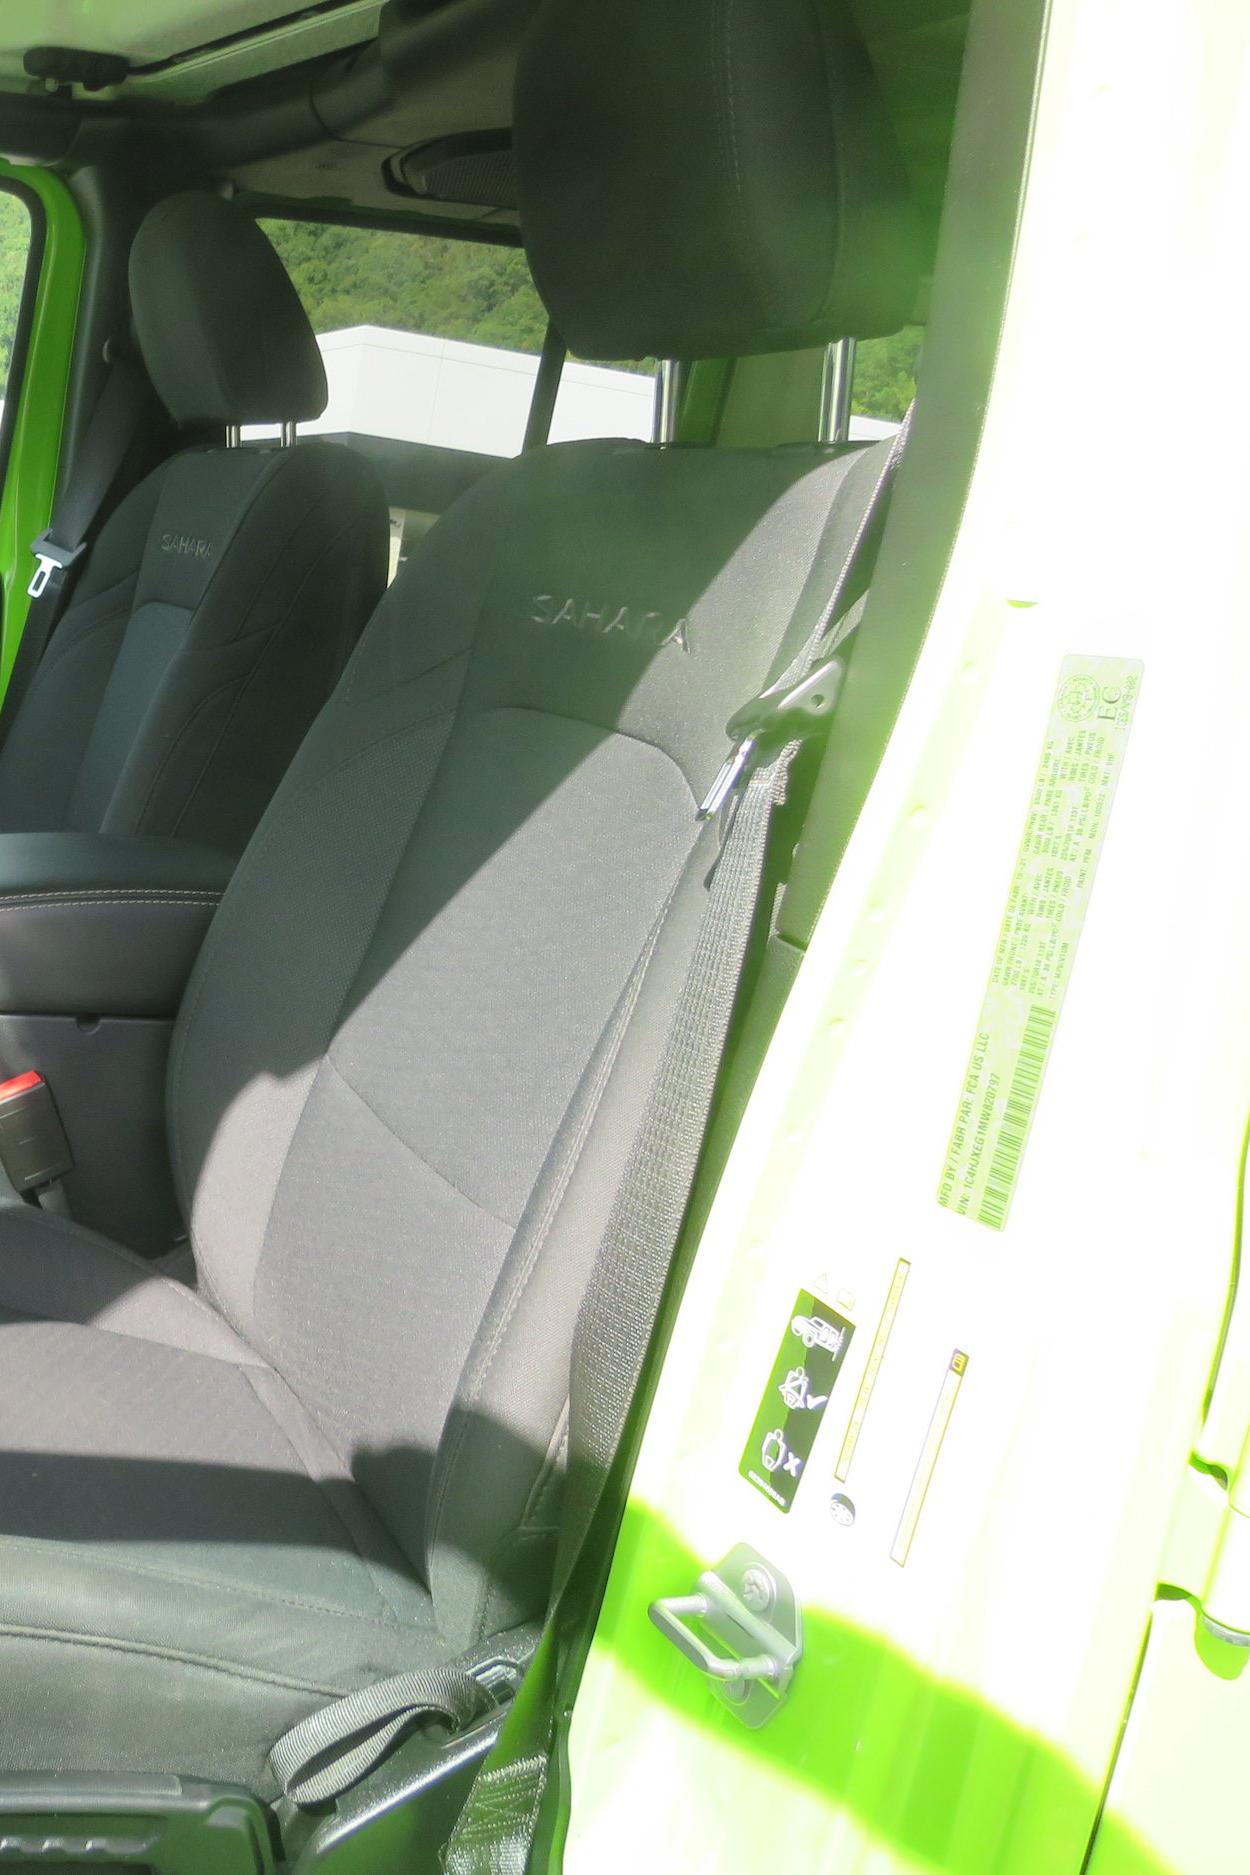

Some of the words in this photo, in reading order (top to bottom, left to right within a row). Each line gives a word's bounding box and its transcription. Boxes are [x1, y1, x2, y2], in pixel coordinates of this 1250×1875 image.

[160, 533, 214, 557] SAHARA
[529, 594, 692, 654] SAHARA
[975, 1031, 989, 1053] LLC
[971, 1054, 984, 1071] US
[965, 1072, 979, 1095] FCA
[958, 1096, 973, 1124] PAR:
[950, 1125, 966, 1155] FABR
[956, 1191, 970, 1216] VIN:
[963, 1071, 1000, 1190] 1C4HJXEG1MW820797
[944, 1164, 956, 1181] BY
[937, 1181, 952, 1208] MFD
